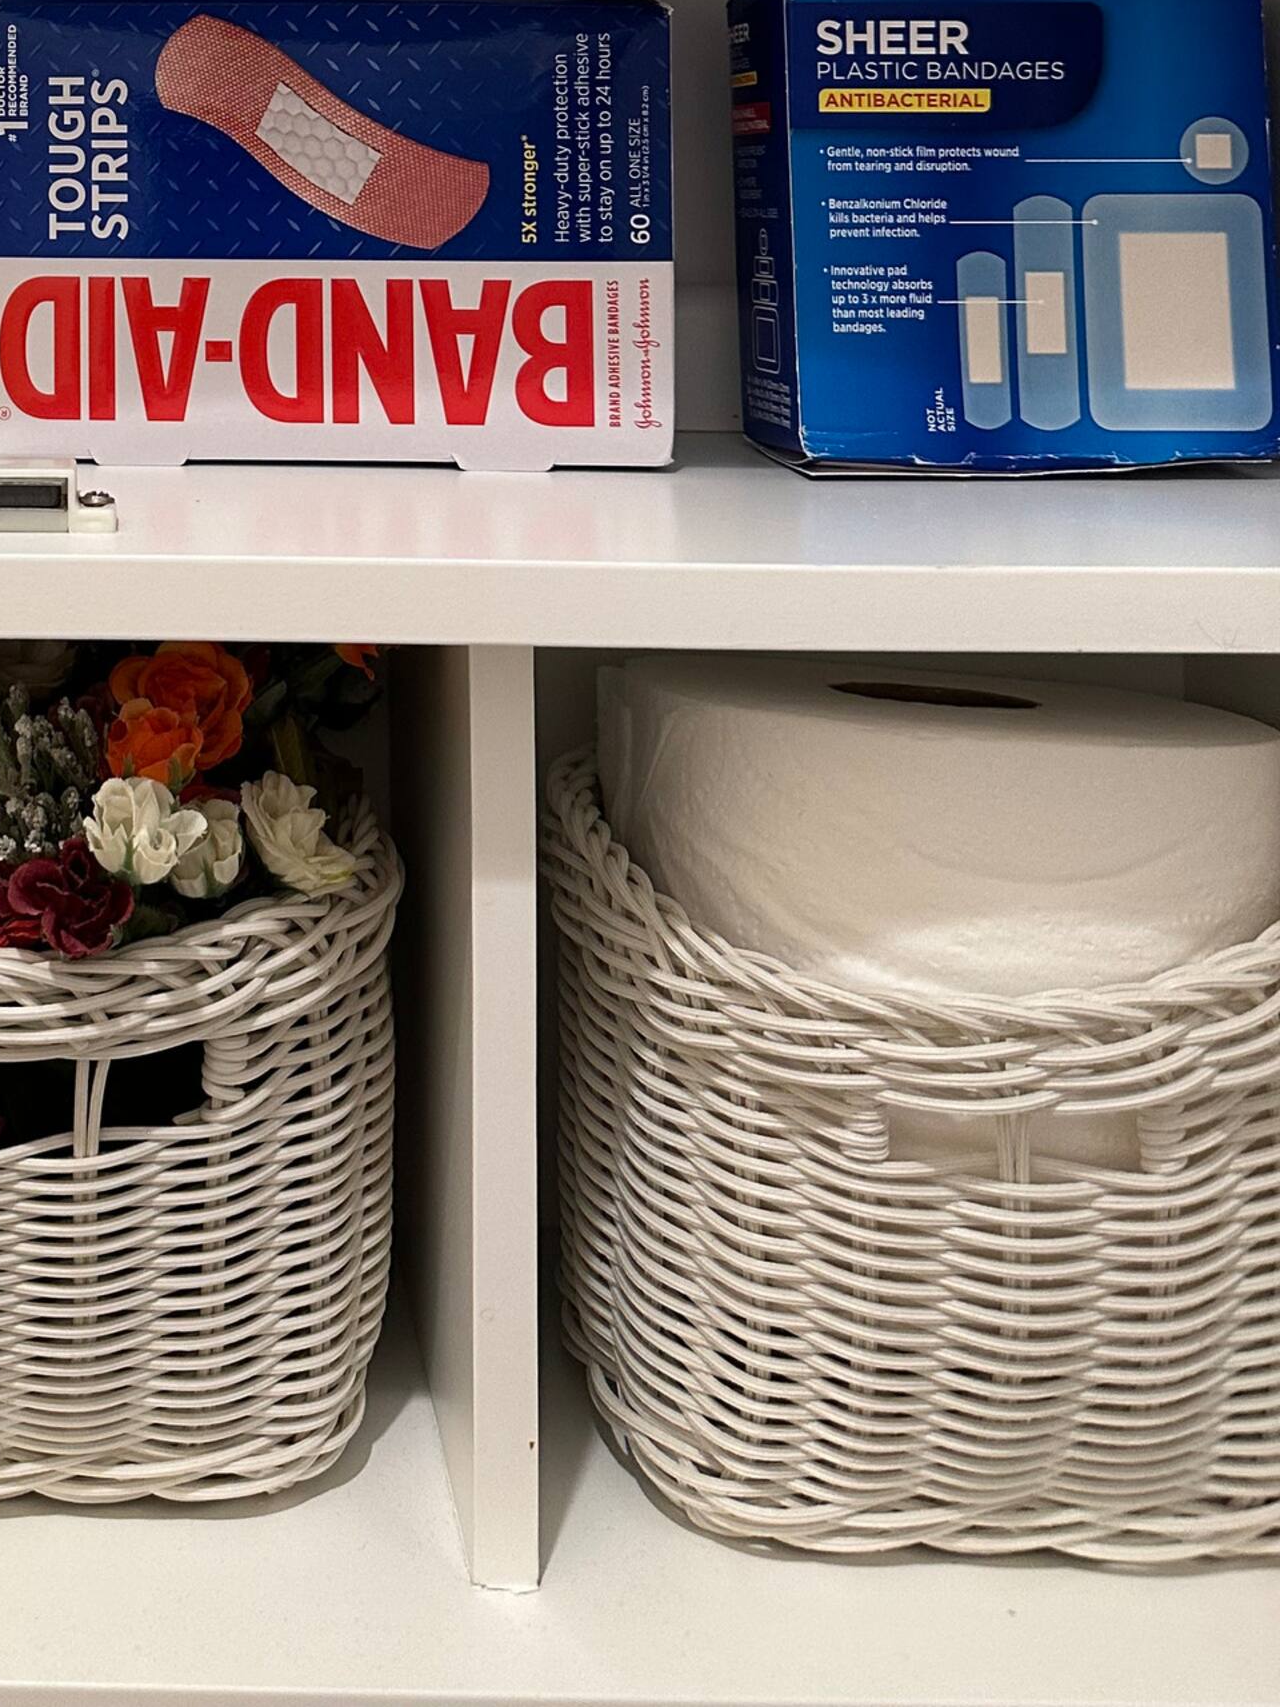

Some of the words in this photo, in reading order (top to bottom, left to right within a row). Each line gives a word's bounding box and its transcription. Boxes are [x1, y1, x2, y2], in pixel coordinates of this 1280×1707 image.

[816, 19, 969, 56] SHEER
[595, 32, 611, 80] hours
[7, 24, 17, 117] RECOMMENDED
[574, 32, 590, 107] adhesive
[816, 61, 918, 80] PLASTIC
[926, 61, 1066, 81] BANDAGES
[19, 74, 29, 117] BRAND
[552, 53, 571, 141] protection
[596, 85, 612, 106] 24
[824, 92, 985, 108] ANTIBACTERIAL
[597, 111, 612, 128] to
[628, 117, 641, 146] SIZE
[599, 133, 615, 153] up
[827, 145, 864, 159] Gentle,
[866, 145, 914, 158] non-stick
[916, 145, 936, 158] film
[938, 146, 982, 160] protects
[984, 146, 1020, 158] wound
[47, 76, 86, 240] TOUGH
[90, 78, 129, 240] STRIPS
[574, 111, 594, 202] super-stick
[599, 156, 612, 181] on
[628, 148, 641, 180] ONE
[827, 160, 853, 172] from
[854, 160, 892, 174] tearing
[894, 160, 914, 172] and
[916, 160, 972, 174] disruption.
[553, 146, 573, 243] Heavy-duty
[598, 185, 616, 221] stay
[629, 183, 641, 208] ALL
[828, 198, 901, 210] Benzalkonium
[903, 198, 948, 210] Chloride
[575, 206, 591, 243] with
[629, 213, 651, 244] 60
[828, 212, 850, 224] kills
[852, 212, 894, 224] bacteria
[896, 212, 916, 224] and
[917, 212, 946, 226] helps
[521, 221, 538, 244] 5X
[598, 225, 613, 243] to
[829, 227, 870, 239] prevent
[872, 226, 921, 238] infection.
[830, 265, 885, 276] Innovative
[887, 265, 908, 278] pad
[831, 279, 890, 292] technology
[891, 279, 933, 290] absorbs
[606, 279, 620, 335] BANDAGES
[831, 294, 844, 306] up
[847, 294, 860, 304] to
[861, 293, 868, 304] 3
[870, 295, 878, 304] x
[879, 294, 907, 304] more
[909, 293, 933, 304] fluid
[832, 307, 856, 319] than
[858, 308, 884, 319] most
[886, 307, 925, 321] leading
[832, 321, 887, 335] bandages.
[607, 337, 621, 387] ADHESIVE
[608, 391, 621, 428] BRAND
[926, 407, 937, 432] NOT
[934, 387, 947, 432] ACTUAL
[945, 407, 957, 432] SIZE
